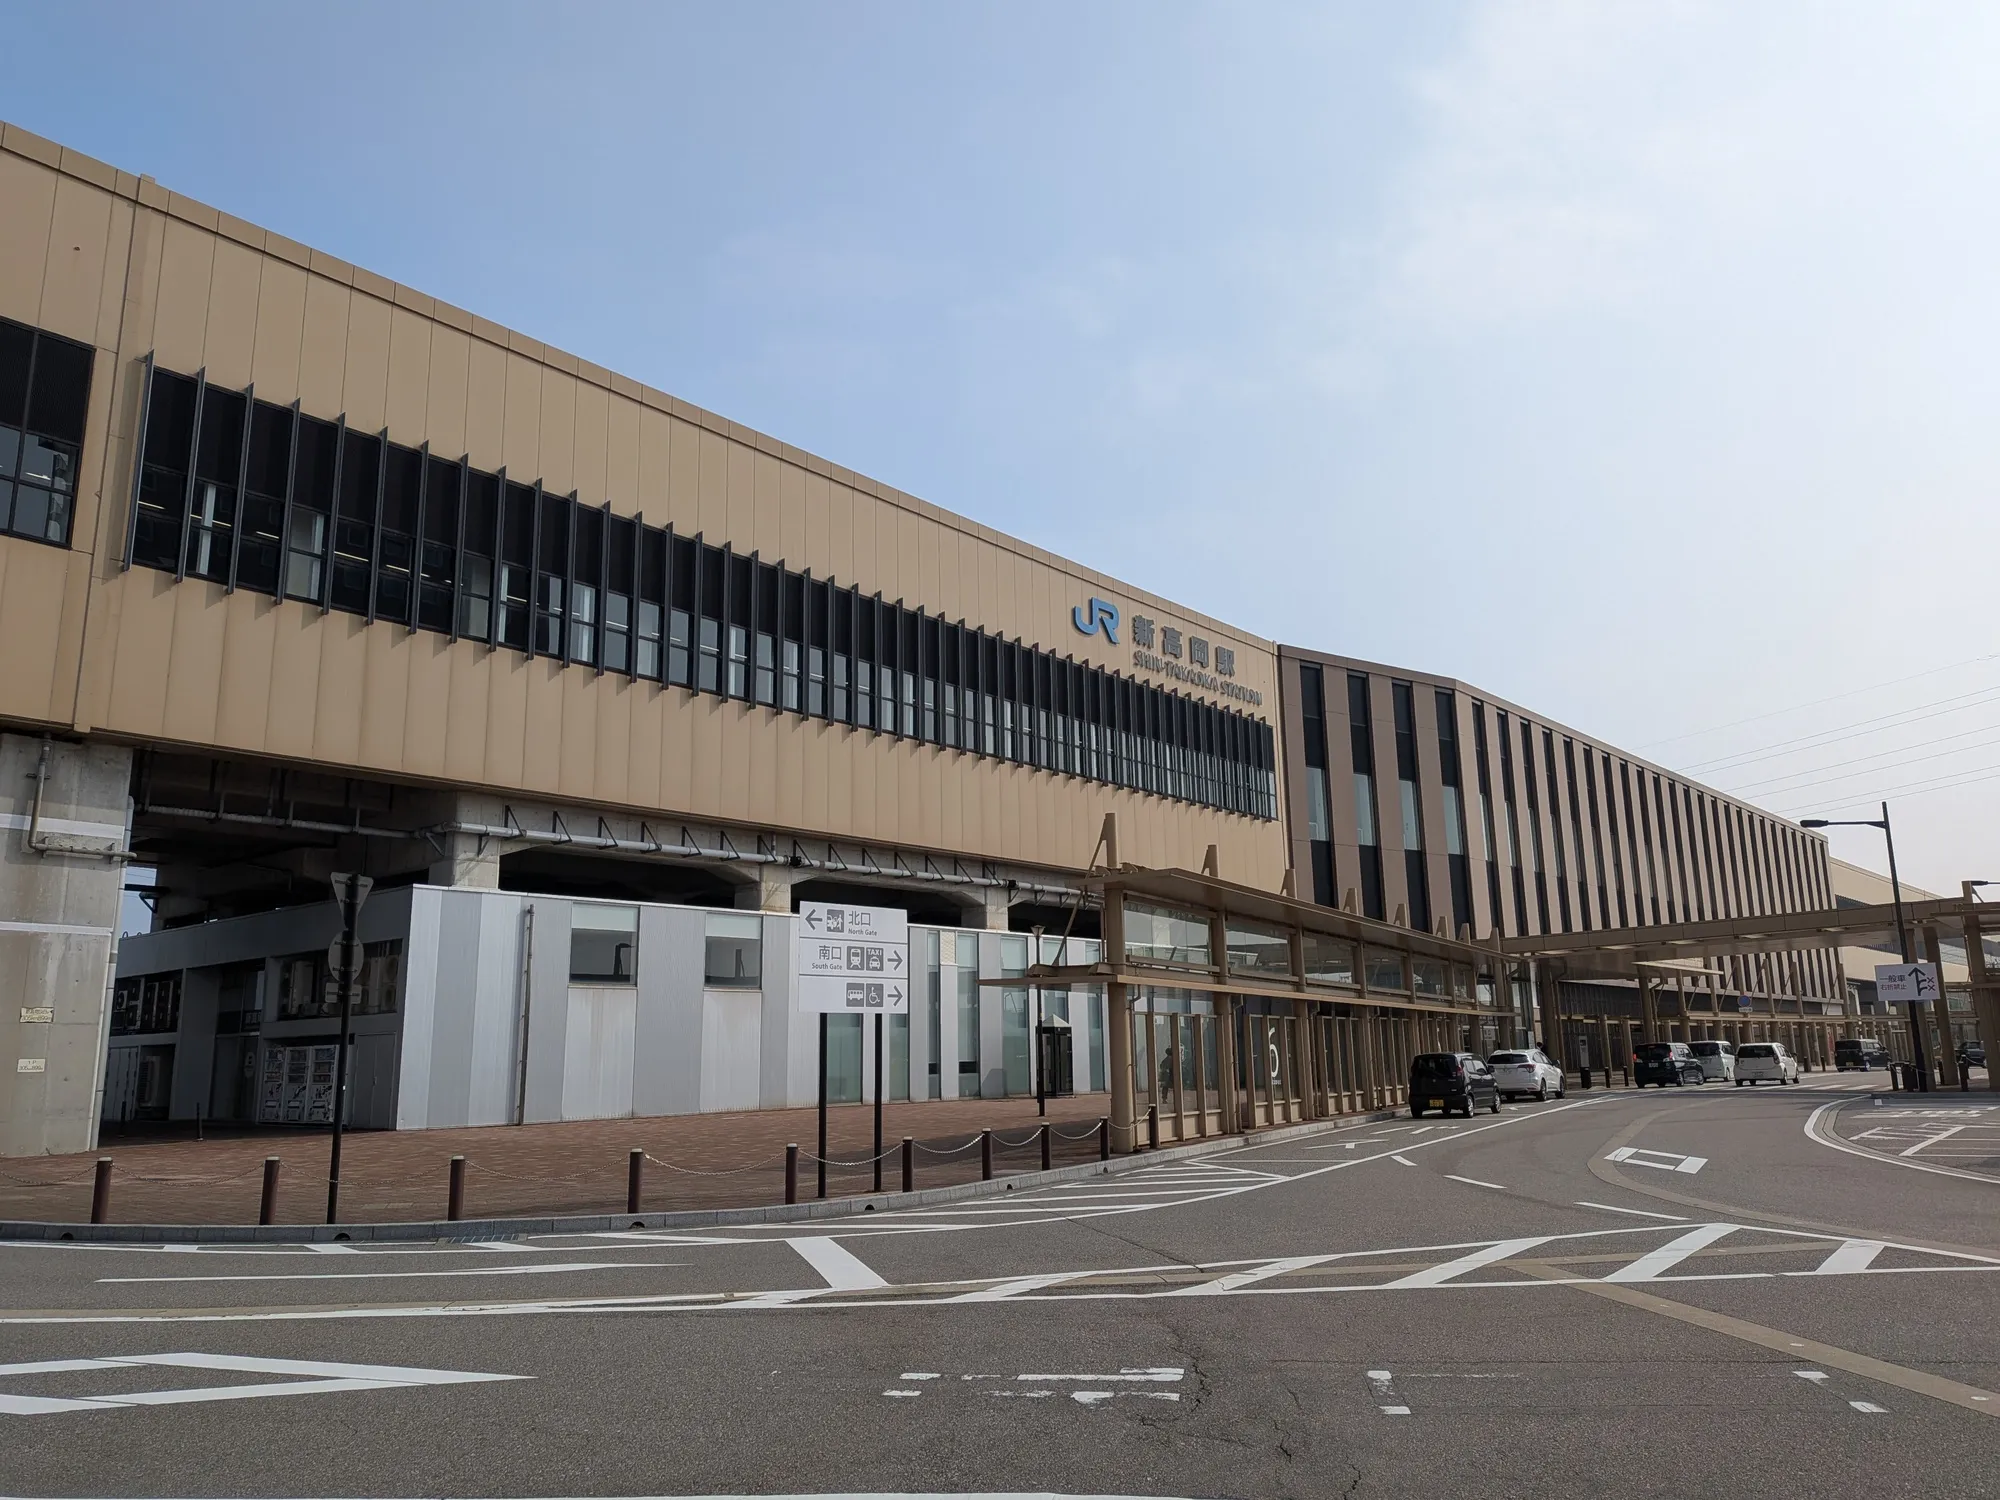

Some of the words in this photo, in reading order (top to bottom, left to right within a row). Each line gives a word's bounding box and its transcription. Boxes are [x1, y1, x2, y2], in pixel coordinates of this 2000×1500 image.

[1073, 597, 1120, 644] JR
[1133, 614, 1235, 677] 新高岡駅
[1220, 680, 1263, 706] STATION
[848, 911, 871, 926] 北口
[818, 945, 842, 960] 南口
[867, 948, 882, 956] TAXI
[1880, 975, 1906, 983] 一般車
